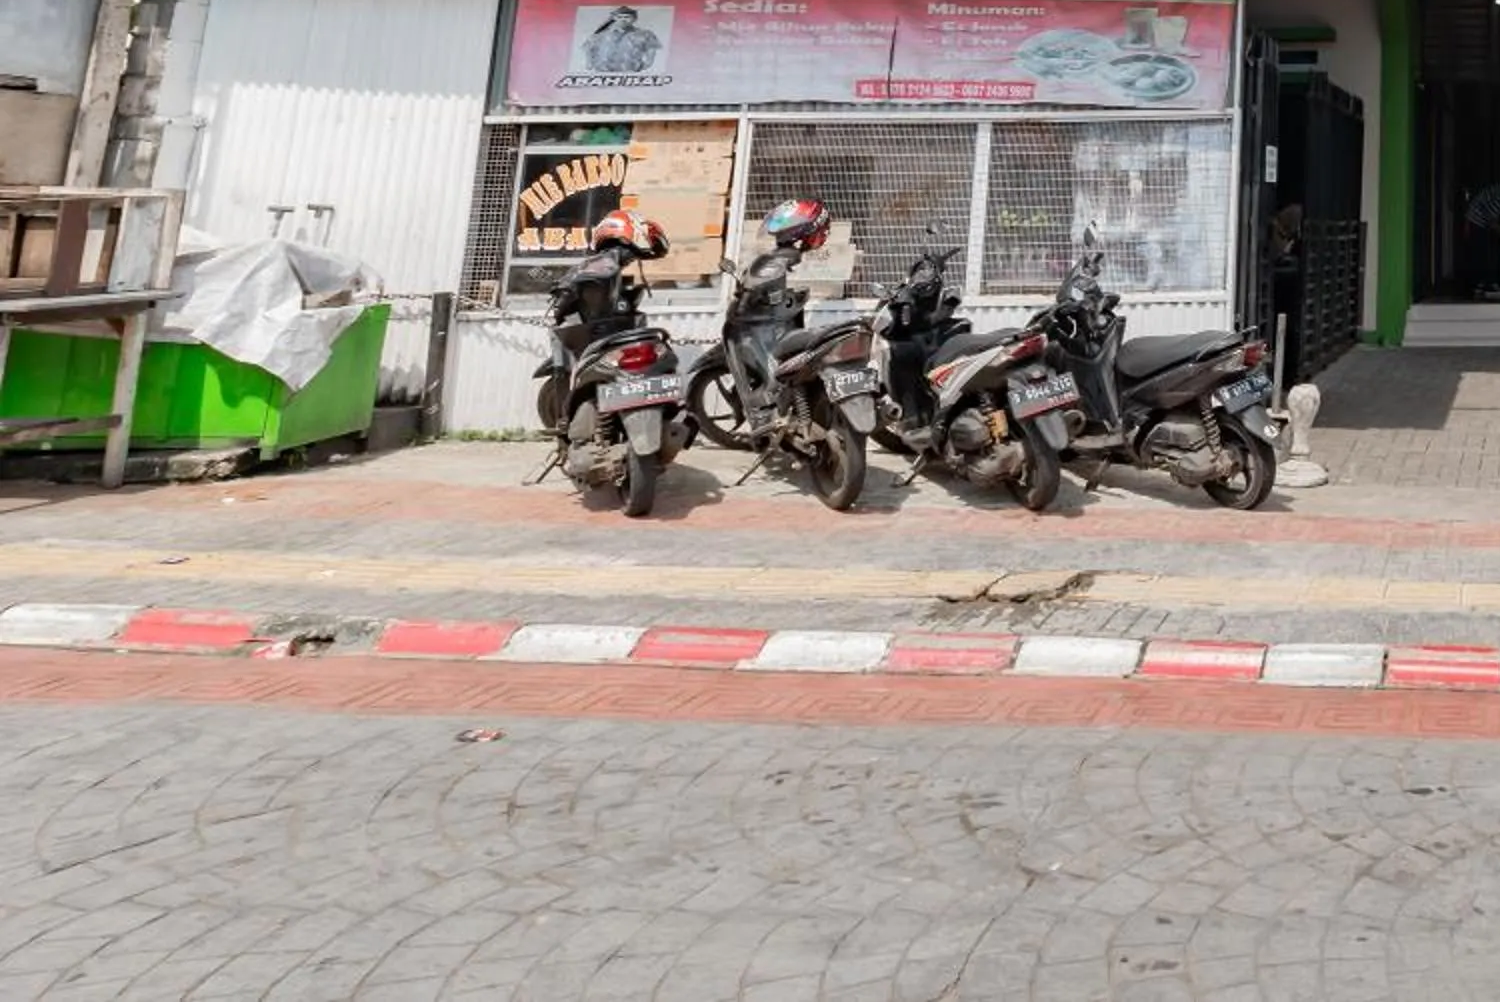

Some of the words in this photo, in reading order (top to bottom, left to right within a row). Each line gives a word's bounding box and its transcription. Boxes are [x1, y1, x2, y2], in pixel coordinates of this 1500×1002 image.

[519, 173, 565, 220] MIE
[555, 152, 626, 198] BAKSO
[517, 227, 597, 251] ABA
